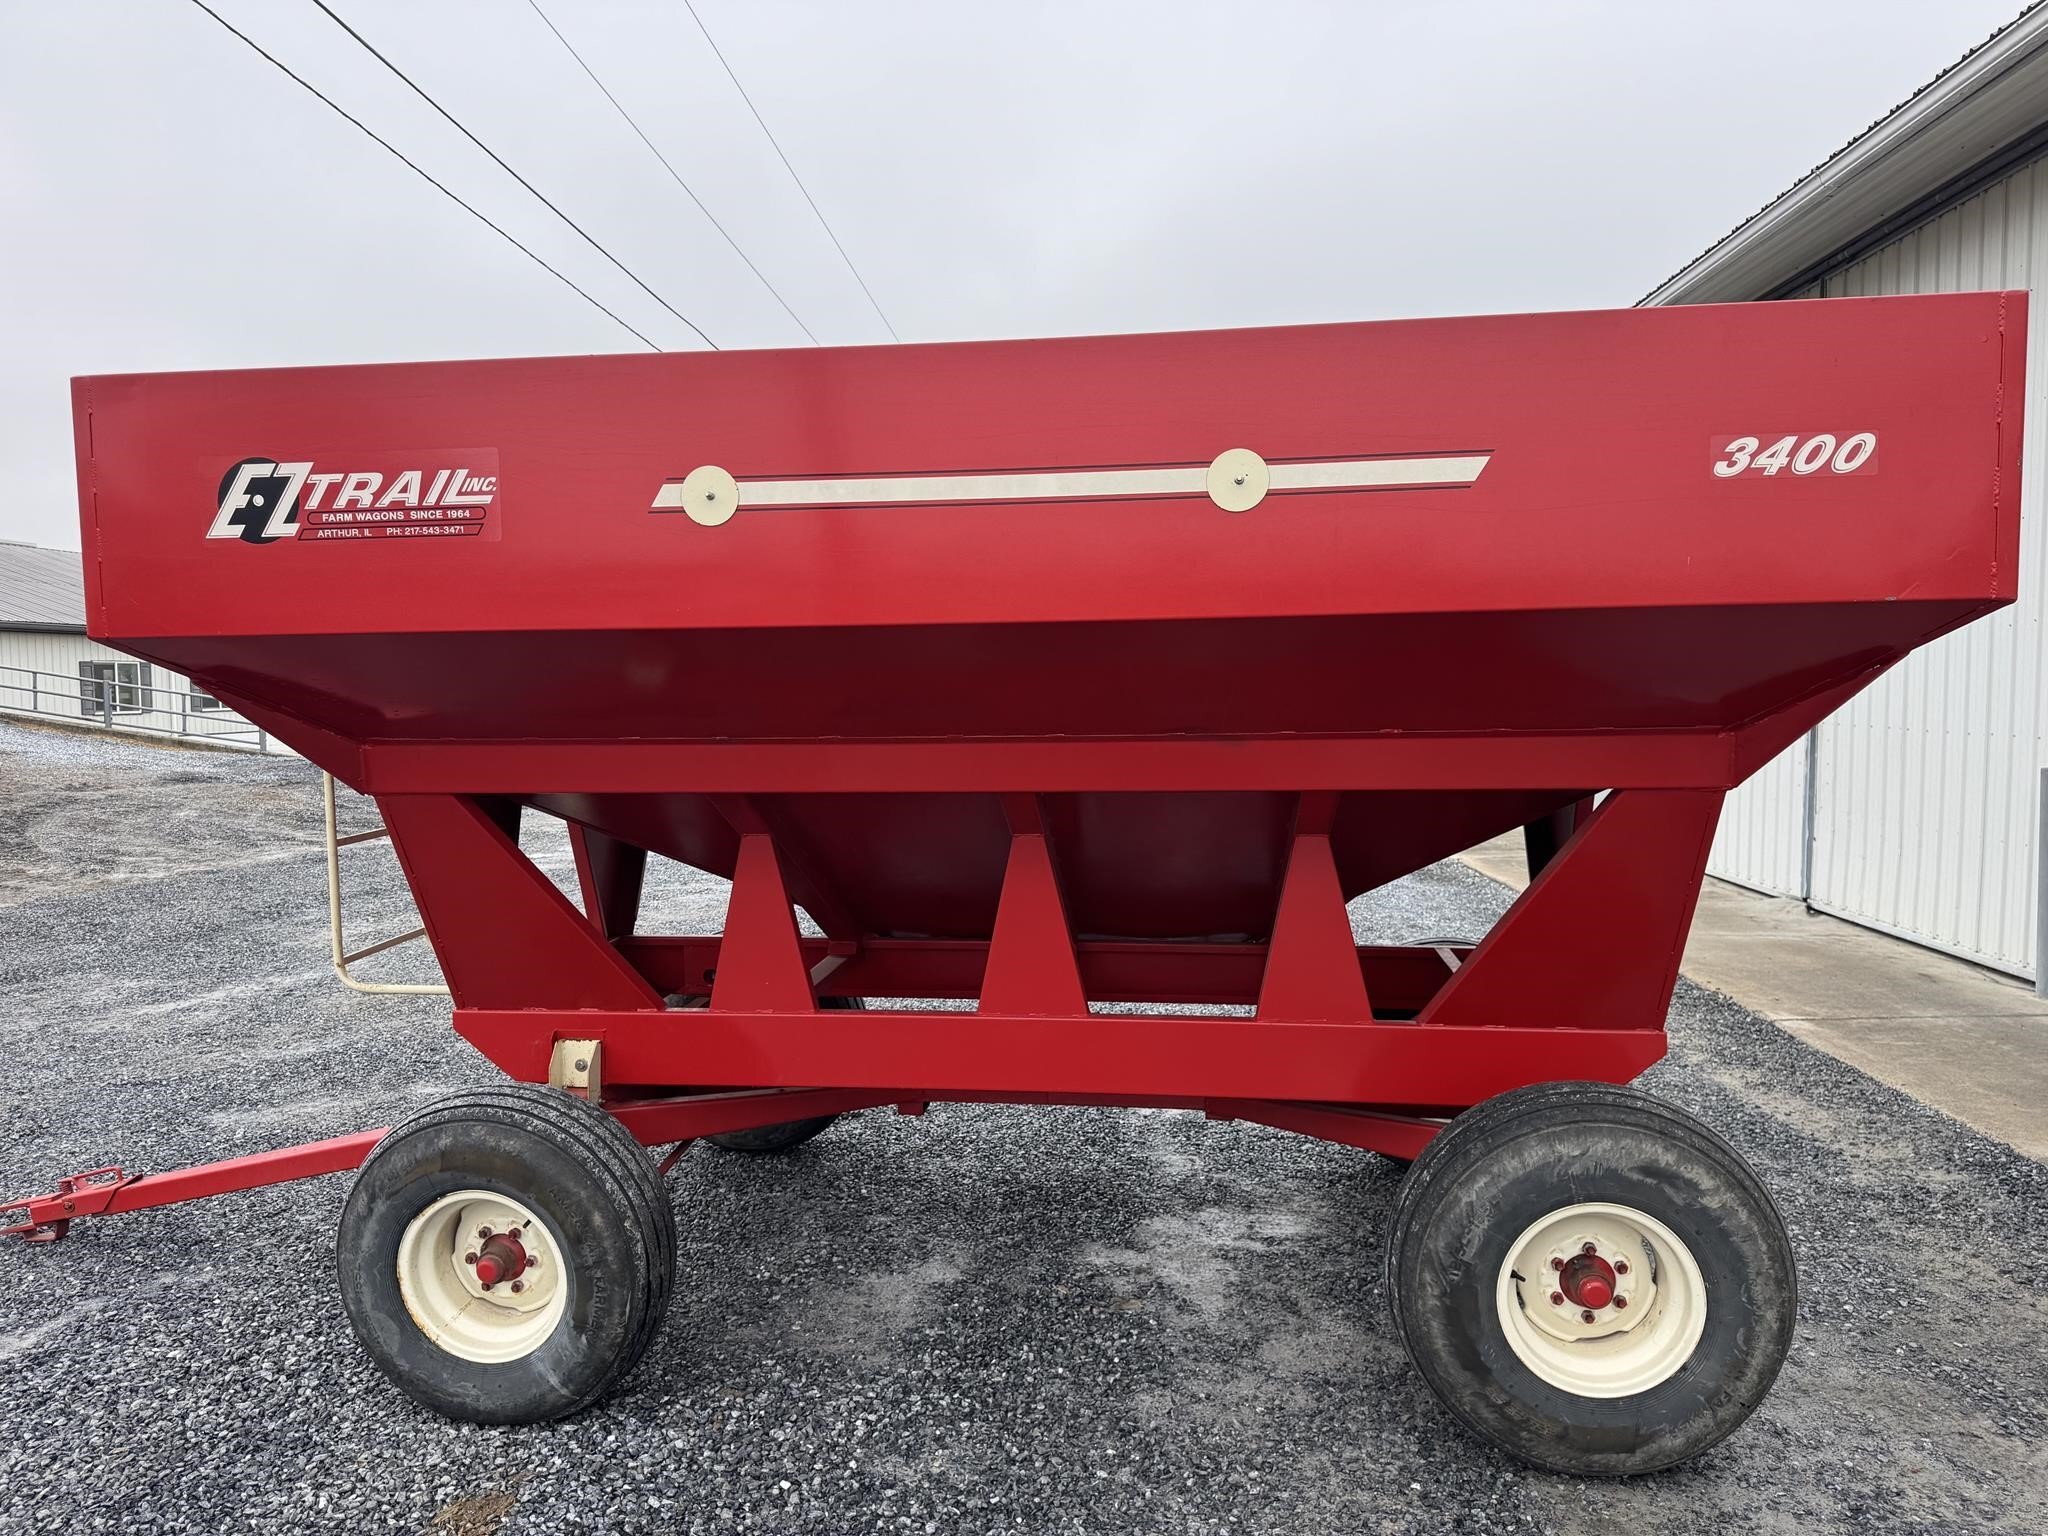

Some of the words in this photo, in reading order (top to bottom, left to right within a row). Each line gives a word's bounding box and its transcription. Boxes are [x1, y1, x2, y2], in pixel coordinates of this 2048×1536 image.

[1713, 432, 1877, 478] 3400
[304, 468, 494, 510] TRAIL
[462, 476, 498, 493] INC.
[322, 512, 353, 522] FARM
[355, 511, 405, 521] WAGONS
[410, 510, 443, 520] SINCE
[446, 509, 471, 519] 1964
[364, 527, 373, 537] IL
[386, 526, 403, 536] PH:
[404, 525, 465, 536] 217-543-3471
